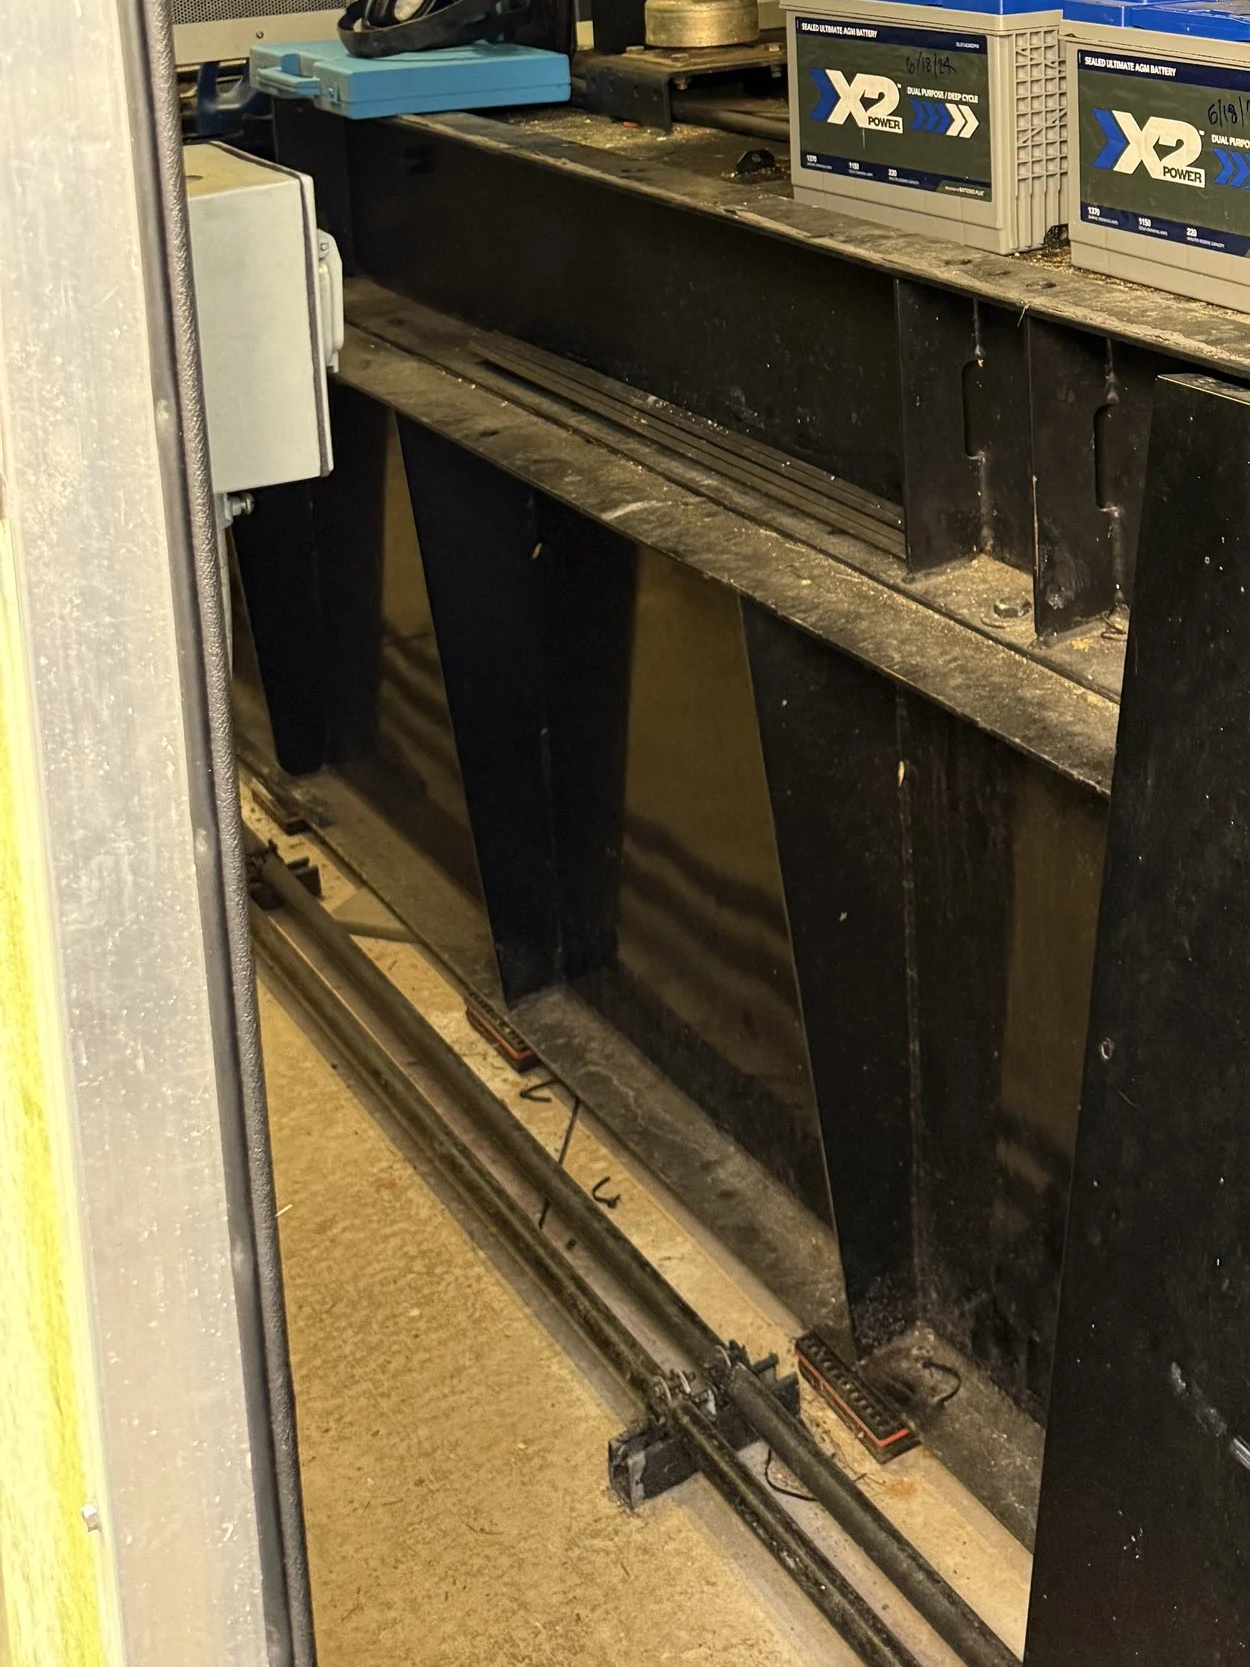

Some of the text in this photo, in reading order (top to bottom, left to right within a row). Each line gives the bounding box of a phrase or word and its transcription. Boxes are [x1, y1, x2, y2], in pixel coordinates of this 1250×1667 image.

[801, 22, 819, 32] SEALED
[820, 24, 842, 34] ULTIMATE
[856, 28, 878, 38] BATTERY
[1084, 56, 1177, 77] SEALED ULTIMATE AGM BATTERY
[825, 69, 900, 127] X2
[907, 86, 921, 96] DUAL
[921, 88, 944, 99] PURPOSE
[948, 92, 962, 101] DEEP
[962, 94, 979, 103] CYCLE
[868, 115, 901, 130] POWER
[1111, 110, 1203, 178] X2
[1211, 134, 1229, 145] DUAL
[1162, 165, 1202, 185] POWER
